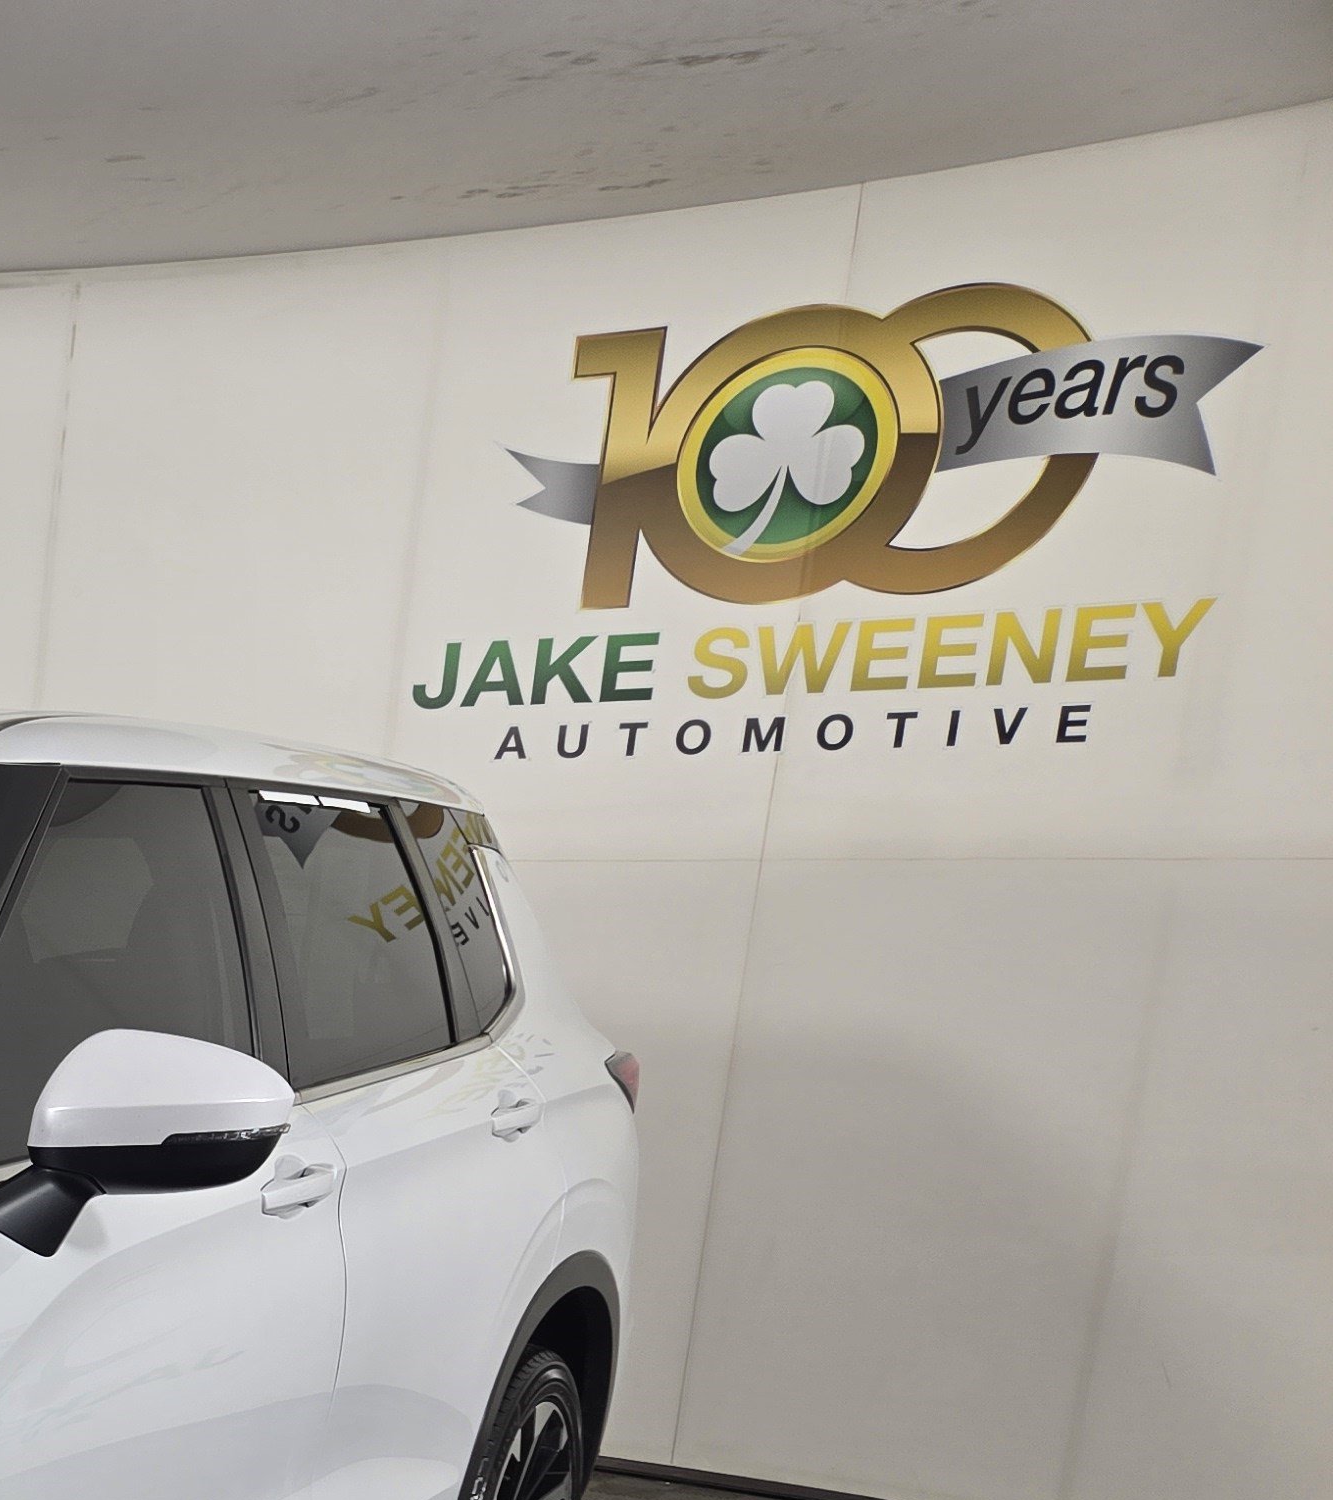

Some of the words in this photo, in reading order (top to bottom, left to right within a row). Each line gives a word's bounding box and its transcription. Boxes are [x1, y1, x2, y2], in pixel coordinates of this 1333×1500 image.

[955, 352, 1186, 455] years
[412, 631, 661, 711] JAKE
[686, 597, 1218, 701] SWEENEY
[494, 704, 1092, 762] AUTOMOTIVE
